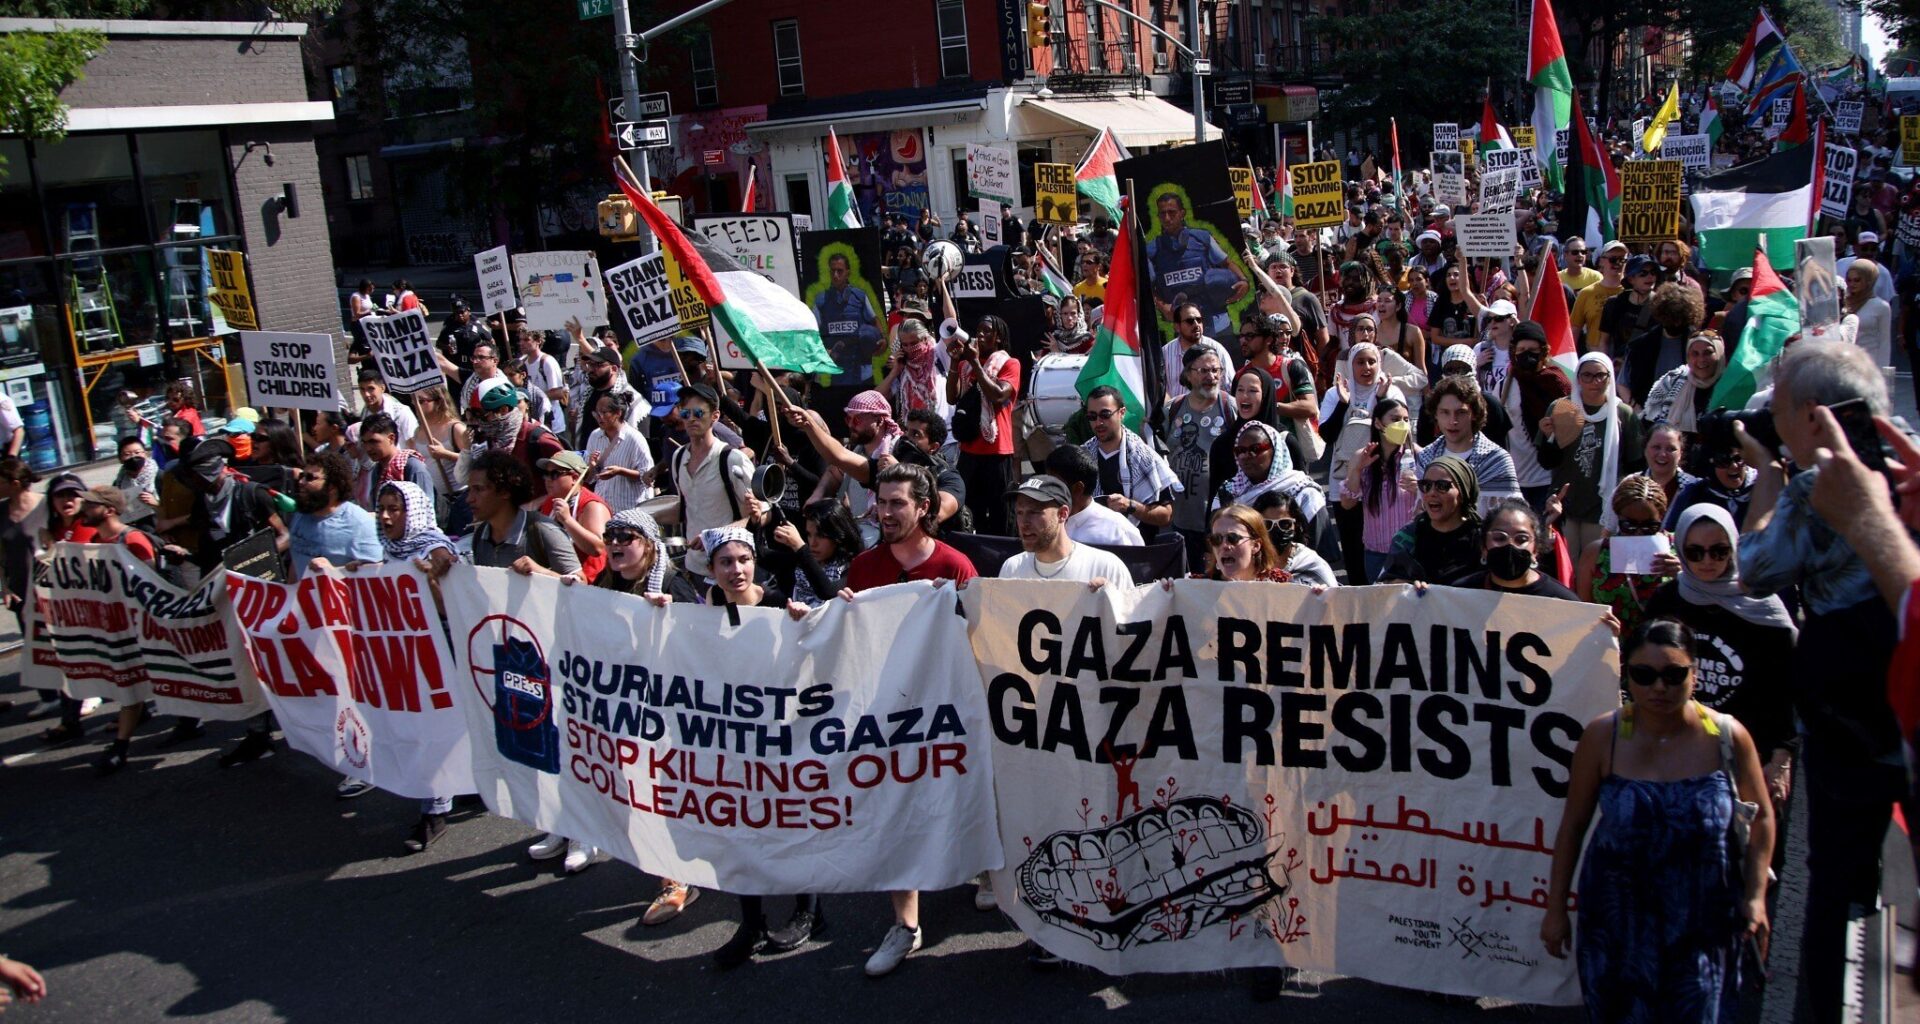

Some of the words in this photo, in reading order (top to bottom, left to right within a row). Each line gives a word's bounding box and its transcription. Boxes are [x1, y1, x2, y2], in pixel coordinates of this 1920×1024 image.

[582, 2, 590, 15] W
[592, 0, 602, 14] 52
[645, 101, 662, 113] WAY
[626, 129, 641, 141] ONE
[649, 127, 664, 139] WAY
[1435, 125, 1457, 133] STAND
[1435, 140, 1457, 150] GAZA
[1664, 145, 1707, 158] GENOCIDE
[1487, 151, 1519, 167] STOP
[1624, 161, 1656, 173] STAND
[1657, 160, 1680, 172] WITH
[1038, 165, 1072, 184] FREE
[1293, 163, 1338, 185] STOP
[1624, 172, 1680, 185] PALESTINE!
[1036, 182, 1076, 195] PALESTINE
[1293, 181, 1341, 197] STARVING
[1484, 180, 1517, 199] GENOCIDE
[1623, 186, 1653, 201] END
[1655, 185, 1679, 200] THE
[1824, 181, 1848, 206] AZA
[1295, 199, 1342, 221] GAZA!
[1622, 201, 1677, 214] OCCUPATION
[701, 219, 781, 244] FEED
[1621, 212, 1676, 236] NOW!
[481, 263, 502, 275] MURDERS
[482, 255, 498, 265] TRUMP
[218, 271, 238, 290] ALL
[487, 279, 504, 290] GAZA'S
[1166, 268, 1202, 284] PRESS
[673, 285, 697, 306] U.S.
[678, 305, 690, 321] TO
[366, 314, 423, 340] STAND
[829, 322, 858, 333] PRESS
[270, 342, 312, 360] STOP
[372, 331, 428, 356] WITH
[254, 360, 326, 380] STARVING
[380, 349, 437, 380] GAZA
[257, 379, 332, 399] CHILDREN
[54, 556, 89, 591] U.S.
[226, 574, 288, 633] TOP
[1017, 609, 1199, 682] GAZA
[1217, 615, 1552, 707] REMAINS
[559, 650, 835, 721] JOURNALISTS
[1694, 669, 1743, 687] ARGO
[562, 682, 665, 742] STAND
[676, 713, 792, 757] WITH
[808, 702, 967, 754] GAZA
[987, 672, 1199, 764] GAZA
[1222, 686, 1585, 799] RESISTS
[566, 717, 640, 771] STOP
[649, 746, 830, 794] KILLING
[846, 742, 968, 789] OUR
[571, 757, 853, 830] COLLEAGUES!
[1307, 795, 1555, 856] لسطين
[1309, 846, 1437, 889] المحتل
[1388, 914, 1441, 931] PALESTINIAN
[1395, 935, 1442, 949] MOVEMENT
[1413, 928, 1441, 940] YOUTH
